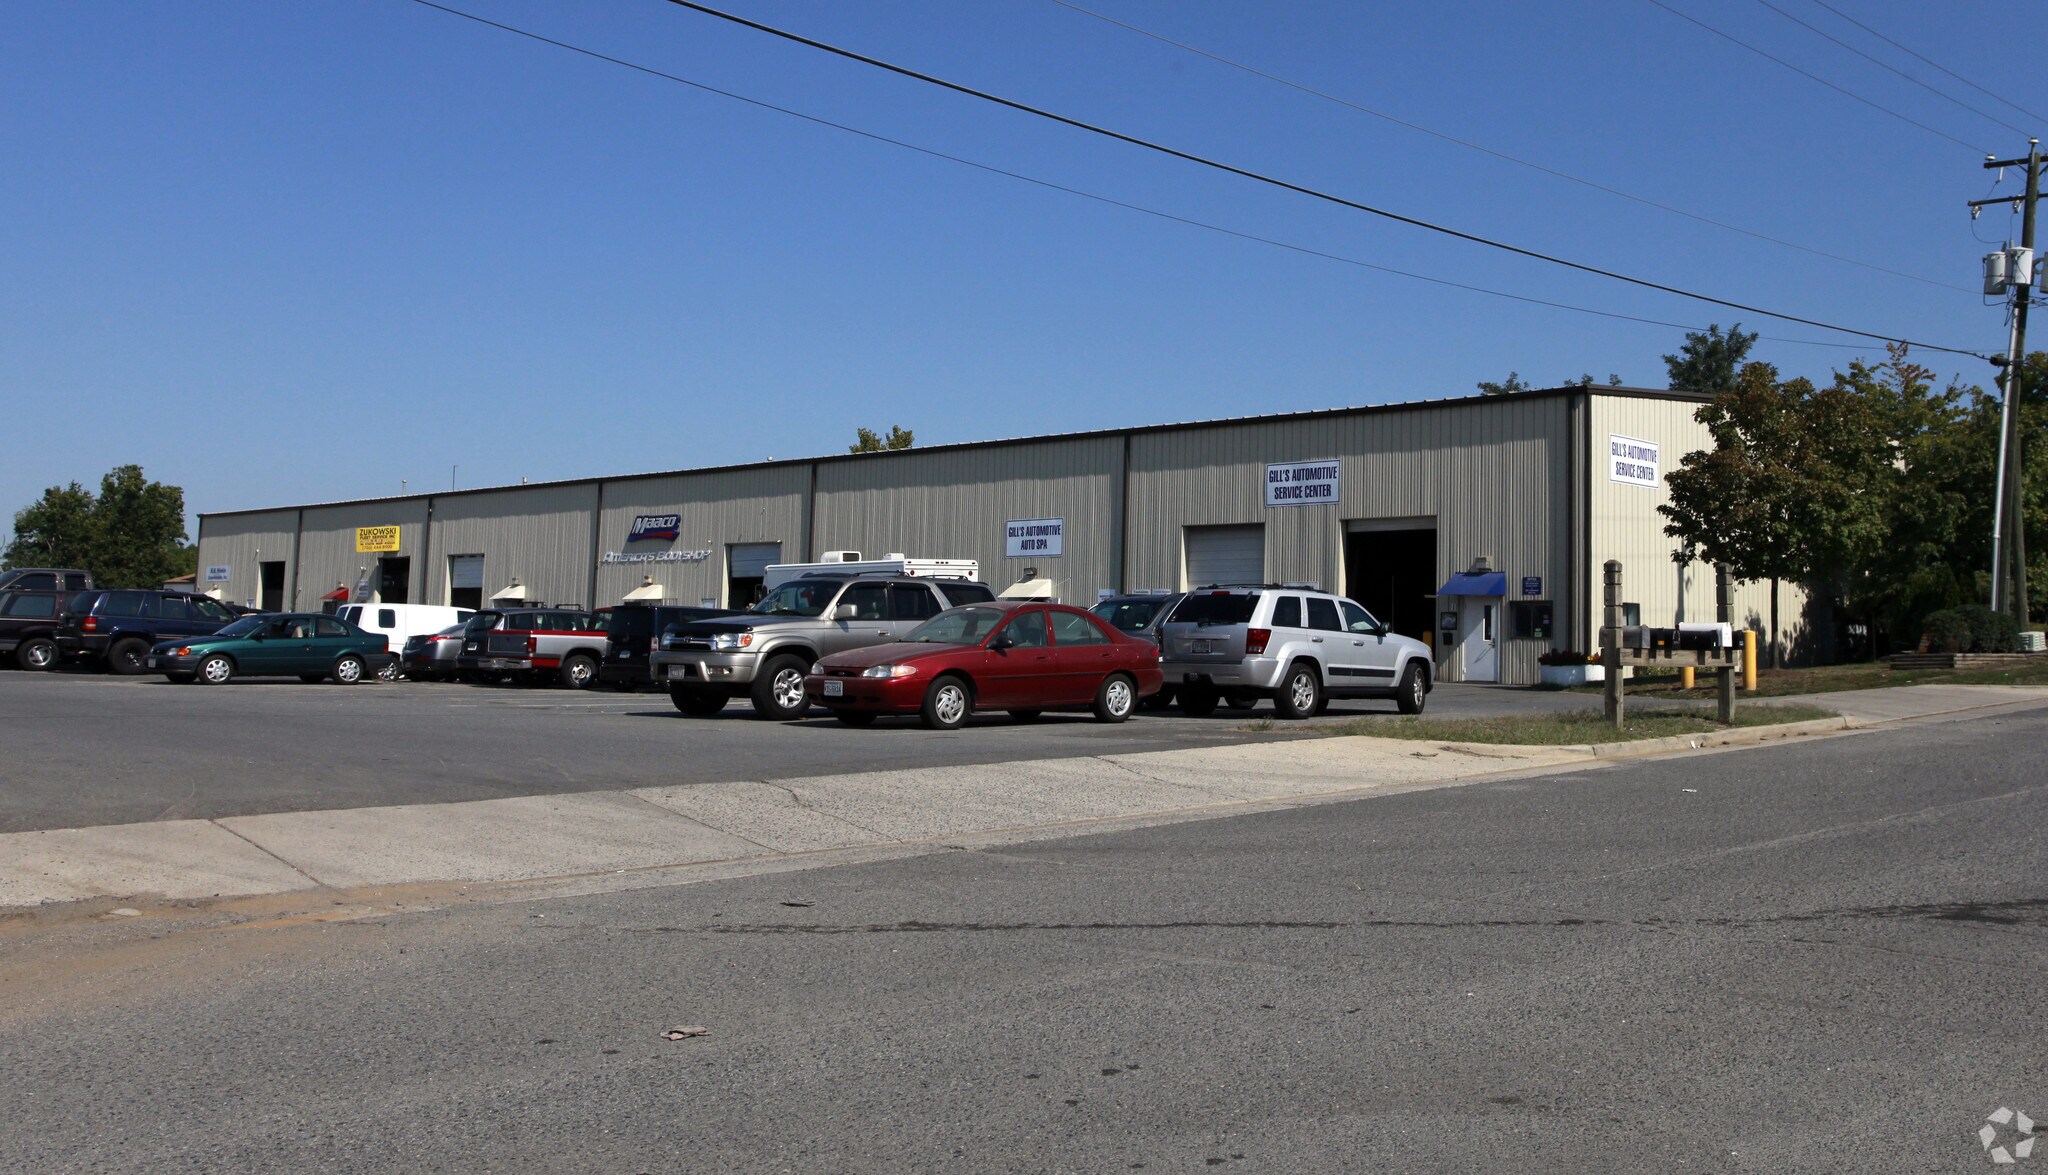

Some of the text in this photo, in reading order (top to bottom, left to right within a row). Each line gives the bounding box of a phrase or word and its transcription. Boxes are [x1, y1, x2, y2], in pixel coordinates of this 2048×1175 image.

[1612, 442, 1657, 463] GILL'S AUTOMOTIVE
[1269, 466, 1337, 483] GILL'S AUTOMOTIVE
[1616, 461, 1654, 481] SERVICE CENTER
[1274, 484, 1331, 500] SERVICE CENTER
[1008, 524, 1061, 537] GILL'S AUTOMOTIVE
[1021, 539, 1047, 550] AUTO SPA
